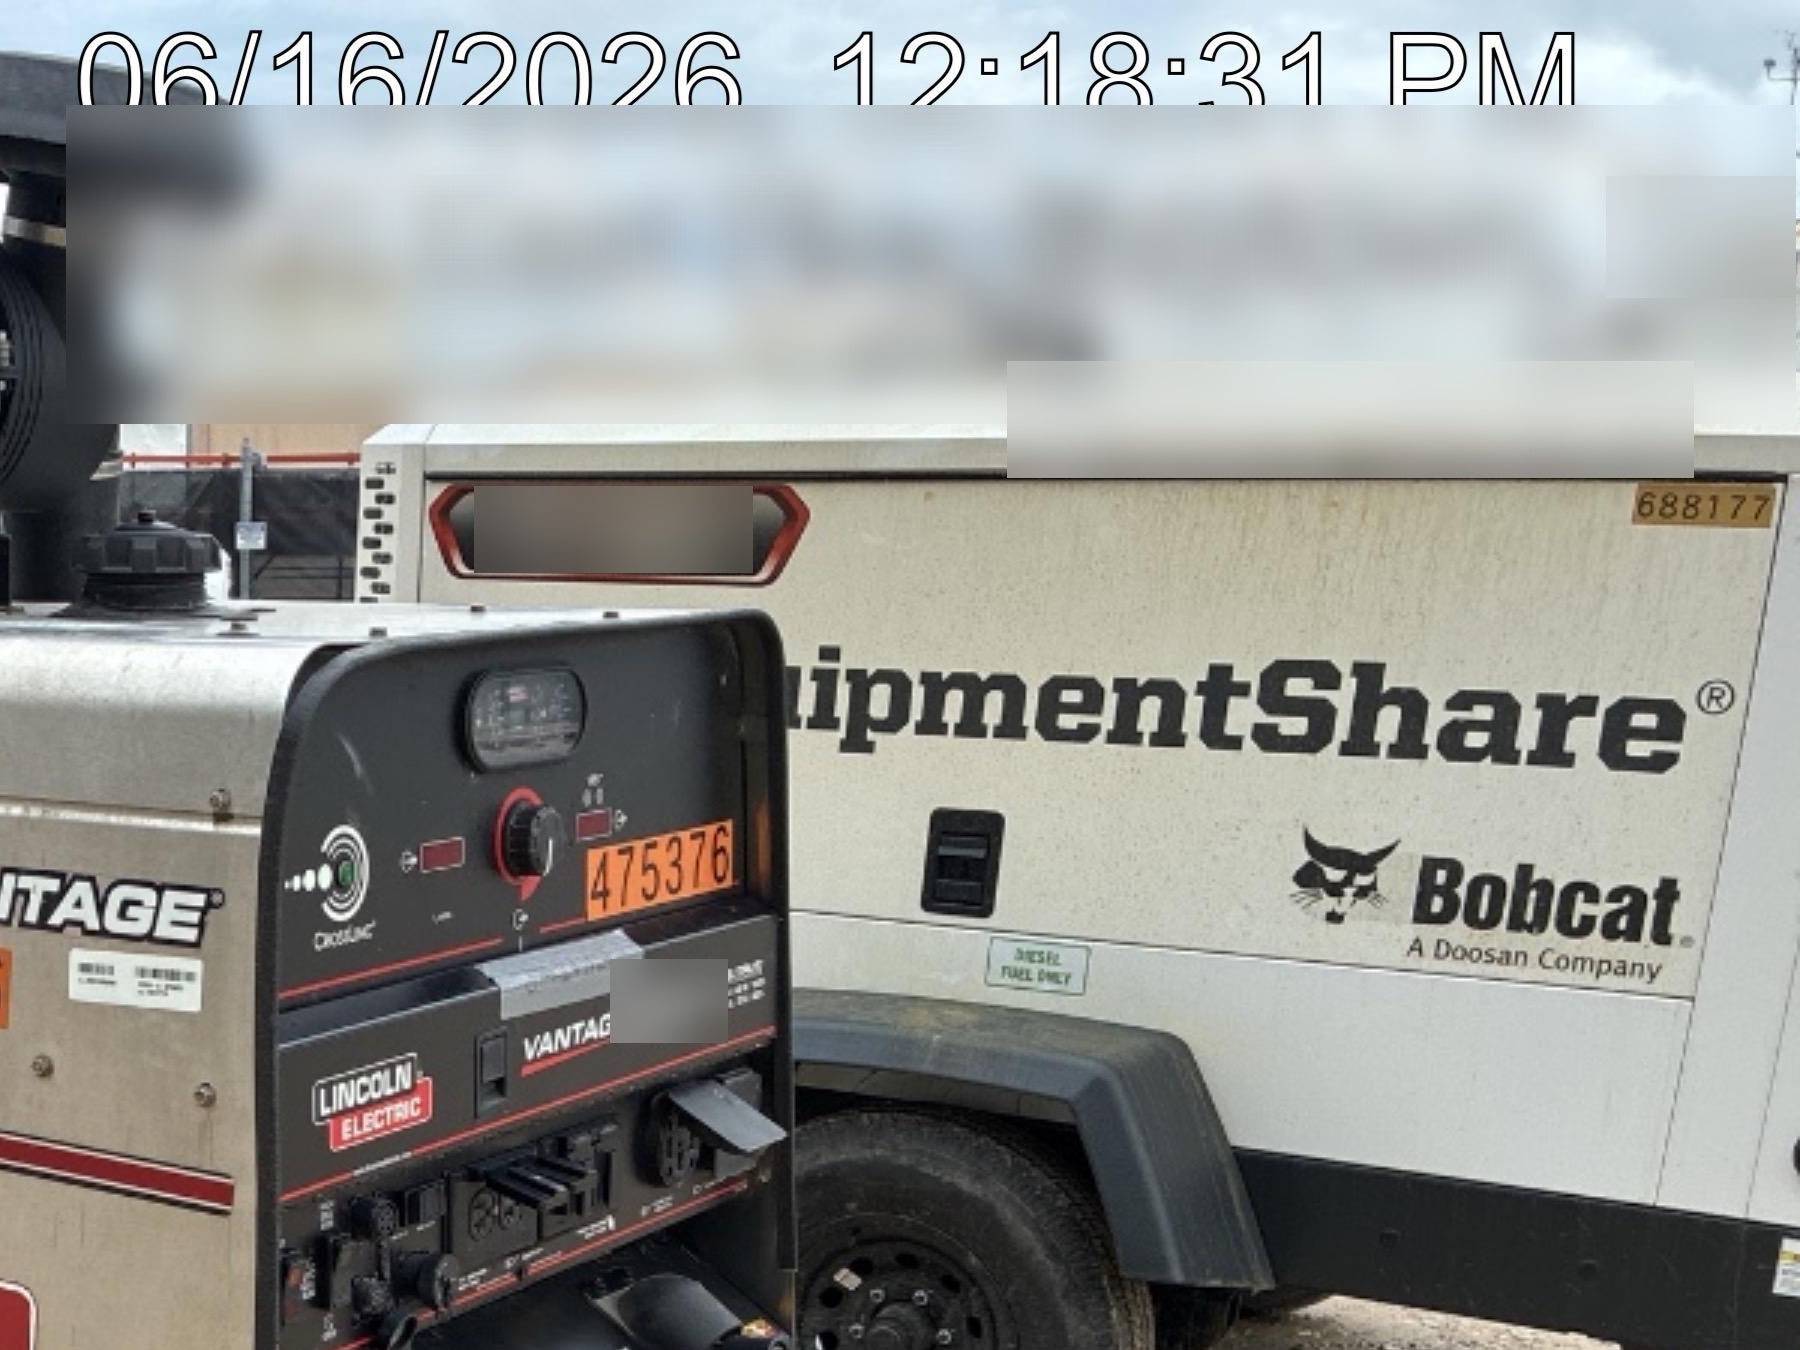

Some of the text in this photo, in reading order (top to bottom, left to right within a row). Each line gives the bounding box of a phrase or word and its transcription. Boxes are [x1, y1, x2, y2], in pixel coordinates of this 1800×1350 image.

[1637, 491, 1771, 522] 688177
[591, 824, 729, 912] 475376
[1413, 856, 1681, 946] Bobcat
[1406, 937, 1663, 983] A Doosan Company
[523, 1013, 610, 1061] VANTAG
[319, 1061, 412, 1117] LINCOLN
[341, 1096, 421, 1141] ELECTRIC
